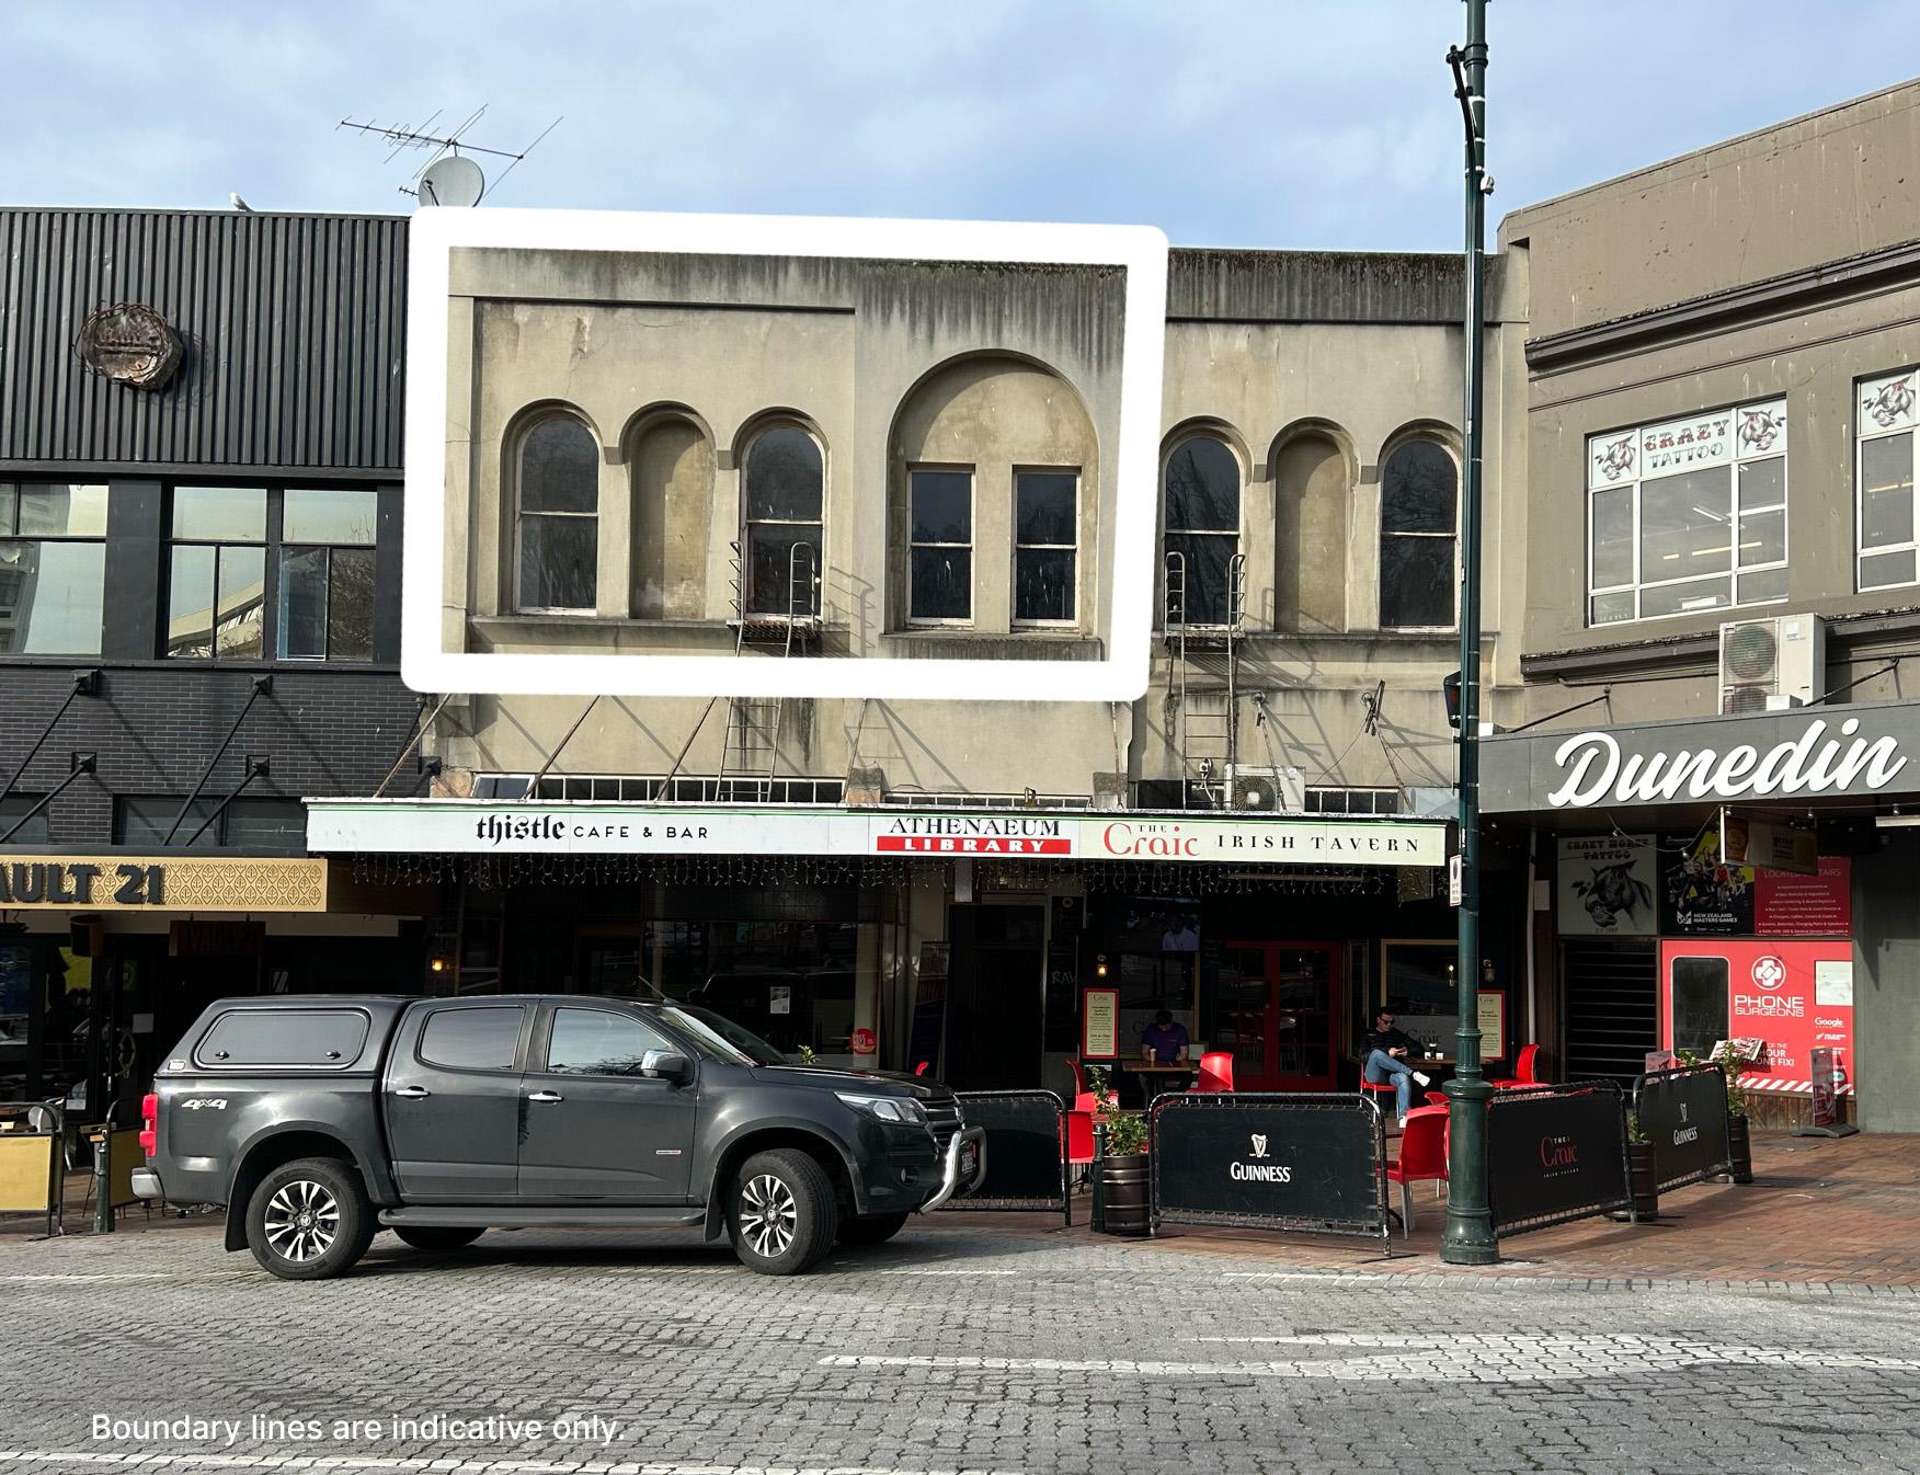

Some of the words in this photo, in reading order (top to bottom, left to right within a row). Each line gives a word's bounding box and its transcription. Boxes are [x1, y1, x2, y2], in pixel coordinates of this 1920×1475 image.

[1644, 418, 1729, 451] CRAZY
[1648, 442, 1723, 468] TATTOO
[1547, 718, 1908, 808] Dunedin
[476, 814, 566, 846] thistle
[573, 826, 629, 838] CAFE
[642, 826, 652, 838] &
[666, 827, 708, 839] BAR
[890, 817, 1060, 836] ATHENAEUM
[1138, 825, 1168, 833] THE
[905, 838, 1046, 853] LIBRARY
[1104, 822, 1199, 857] Craic
[1218, 835, 1294, 849] IRISH
[1311, 836, 1419, 852] TAVERN
[113, 864, 164, 905] 21
[1734, 994, 1805, 1009] PHONE
[1735, 1006, 1805, 1017] SURGEONS
[1814, 1016, 1844, 1027] Google
[1672, 1126, 1698, 1146] GUINNESS
[1230, 1161, 1291, 1183] GUINNESS
